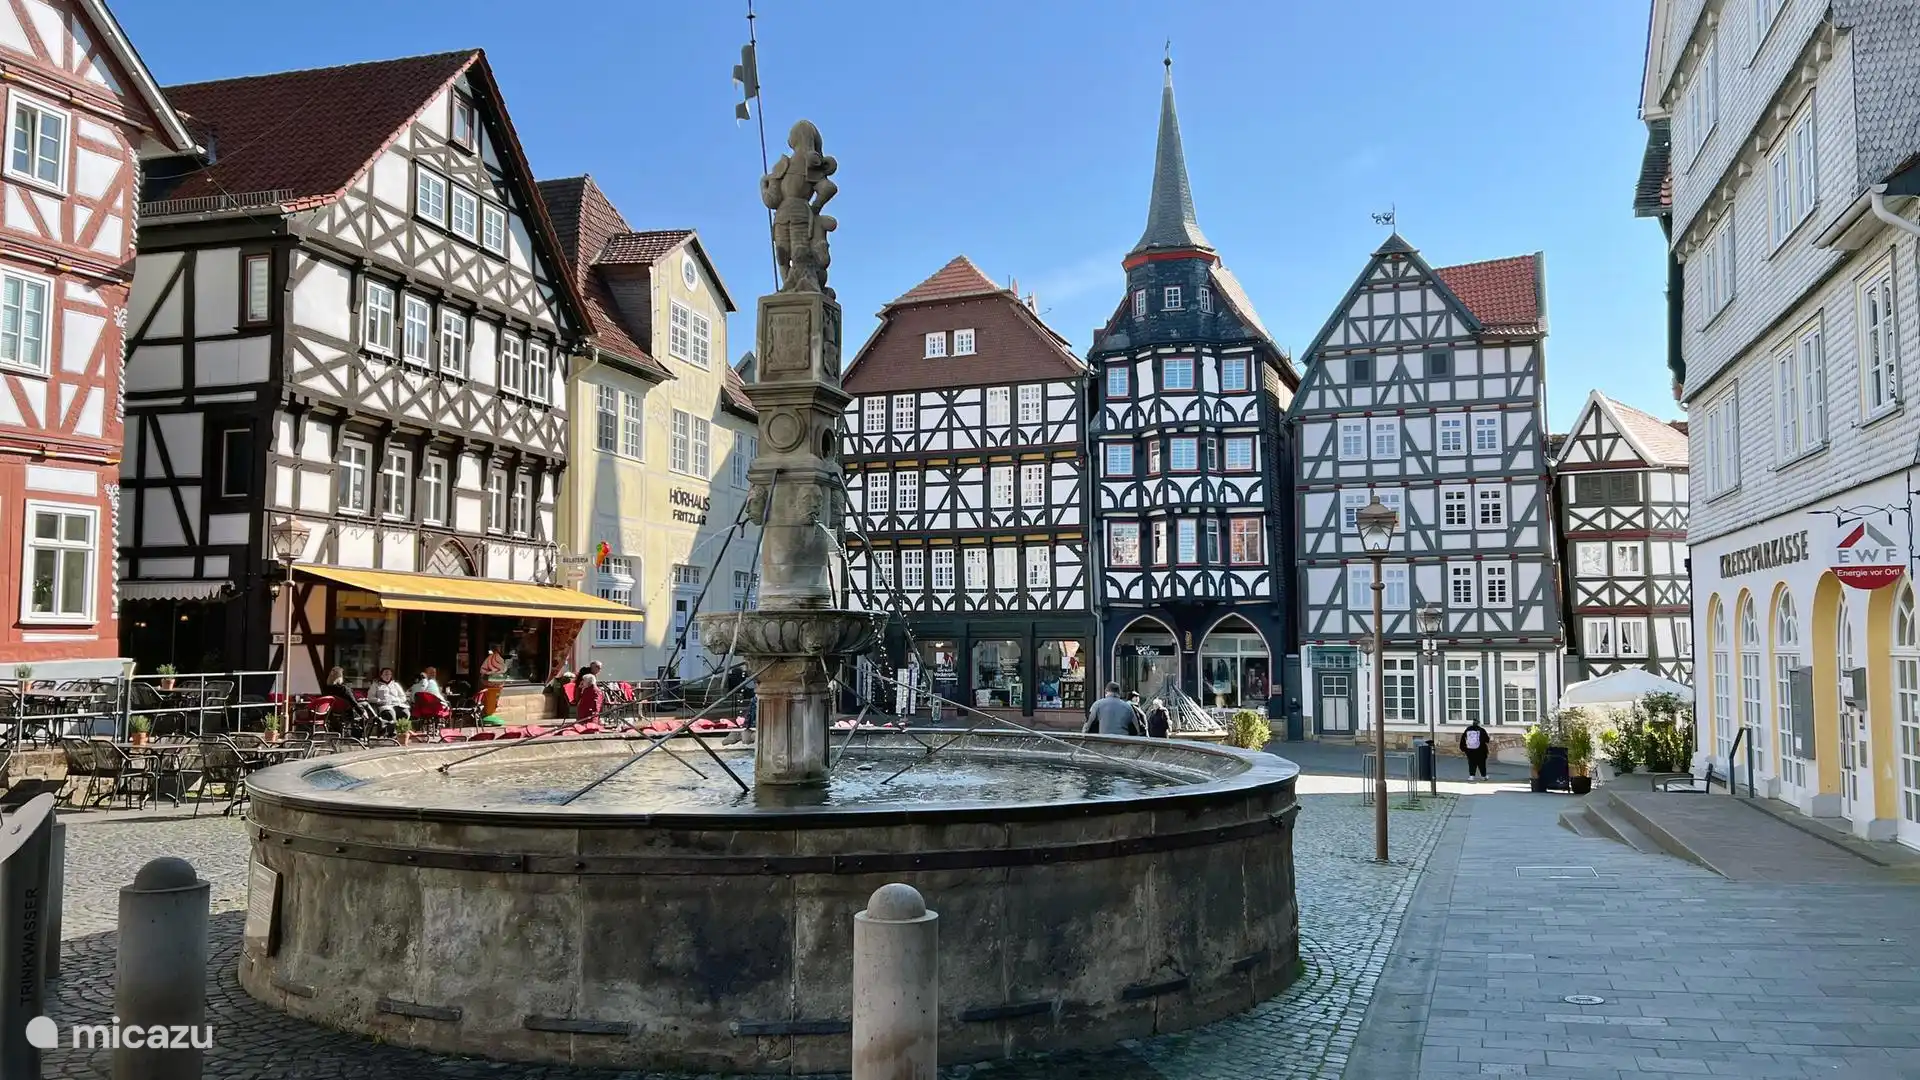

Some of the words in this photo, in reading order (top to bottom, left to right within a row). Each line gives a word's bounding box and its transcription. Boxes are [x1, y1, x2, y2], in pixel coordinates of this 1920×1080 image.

[669, 487, 710, 511] HÖRHAUS
[672, 509, 706, 526] FRITZLAR
[1719, 530, 1809, 578] KREISSPARKASSE
[1838, 548, 1897, 563] EWF
[1837, 569, 1868, 578] Energie
[1884, 568, 1900, 577] Ort!
[19, 887, 40, 1008] TRINKWASSER
